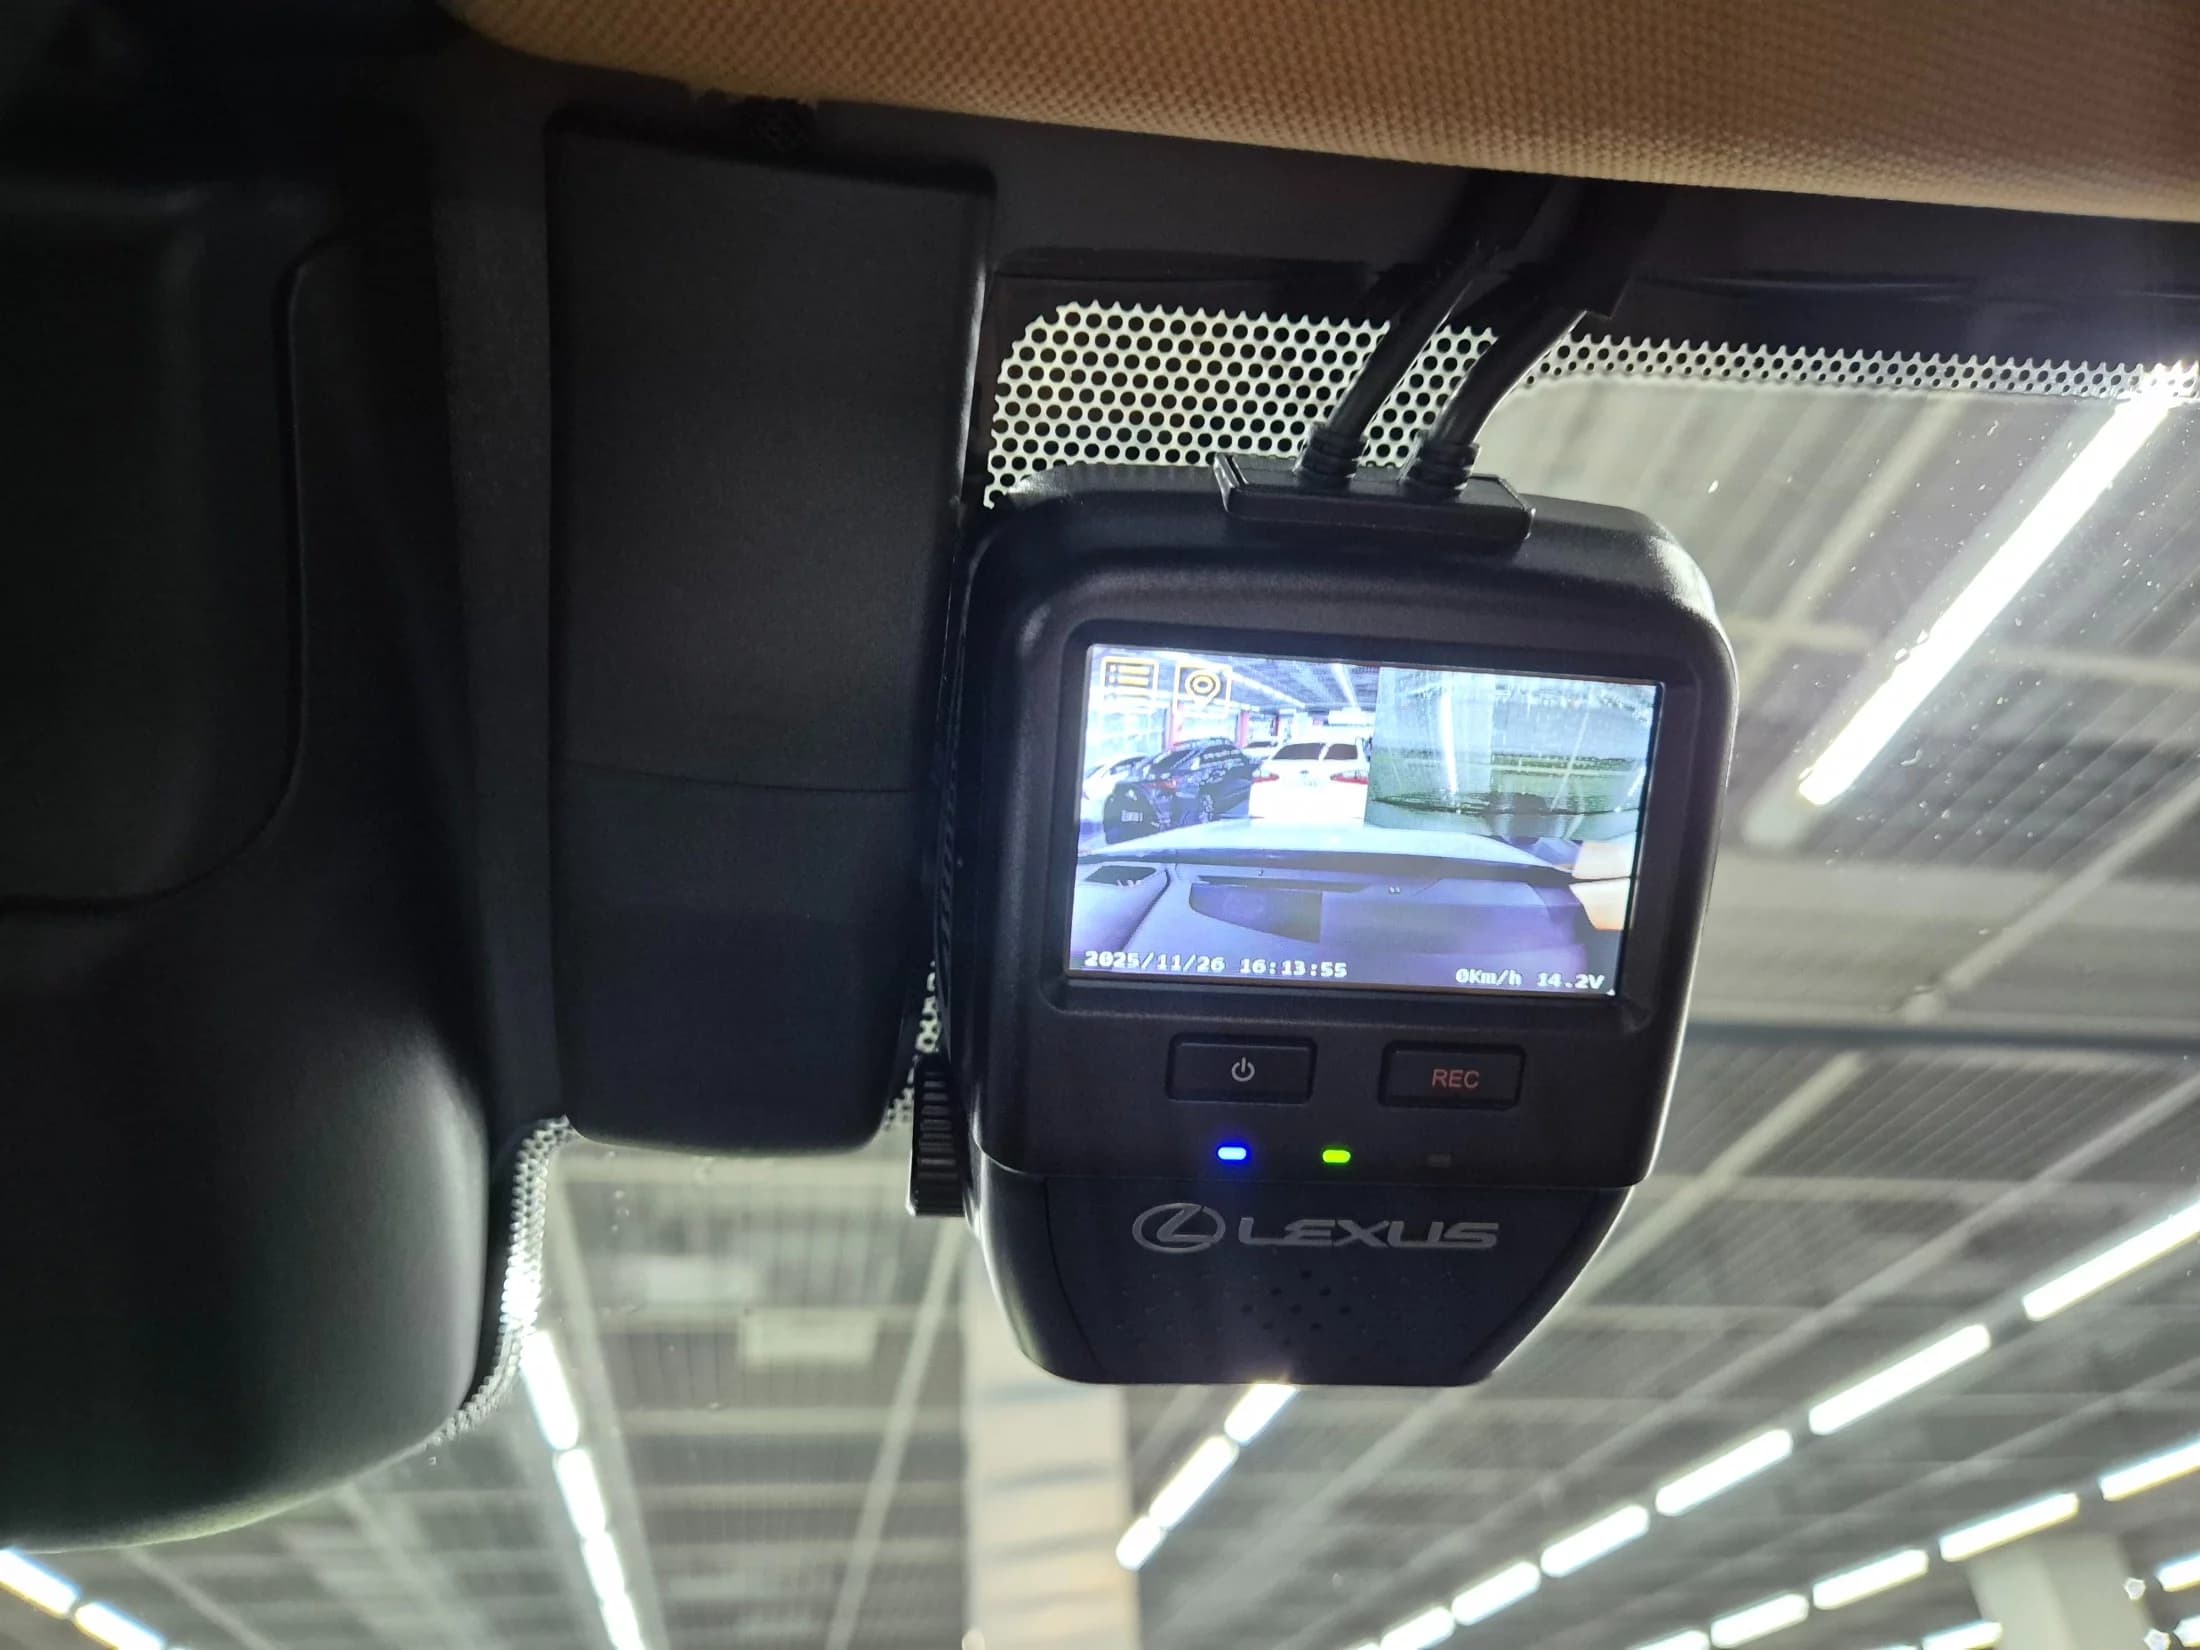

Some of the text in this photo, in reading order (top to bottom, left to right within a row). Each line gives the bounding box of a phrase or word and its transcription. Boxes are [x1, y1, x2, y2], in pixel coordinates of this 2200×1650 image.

[1084, 950, 1348, 978] 2025/11/26 16:13:55
[1455, 968, 1605, 989] 0Km/h 14.2V
[1431, 1069, 1480, 1089] REC
[1238, 1216, 1500, 1249] LEXUS
